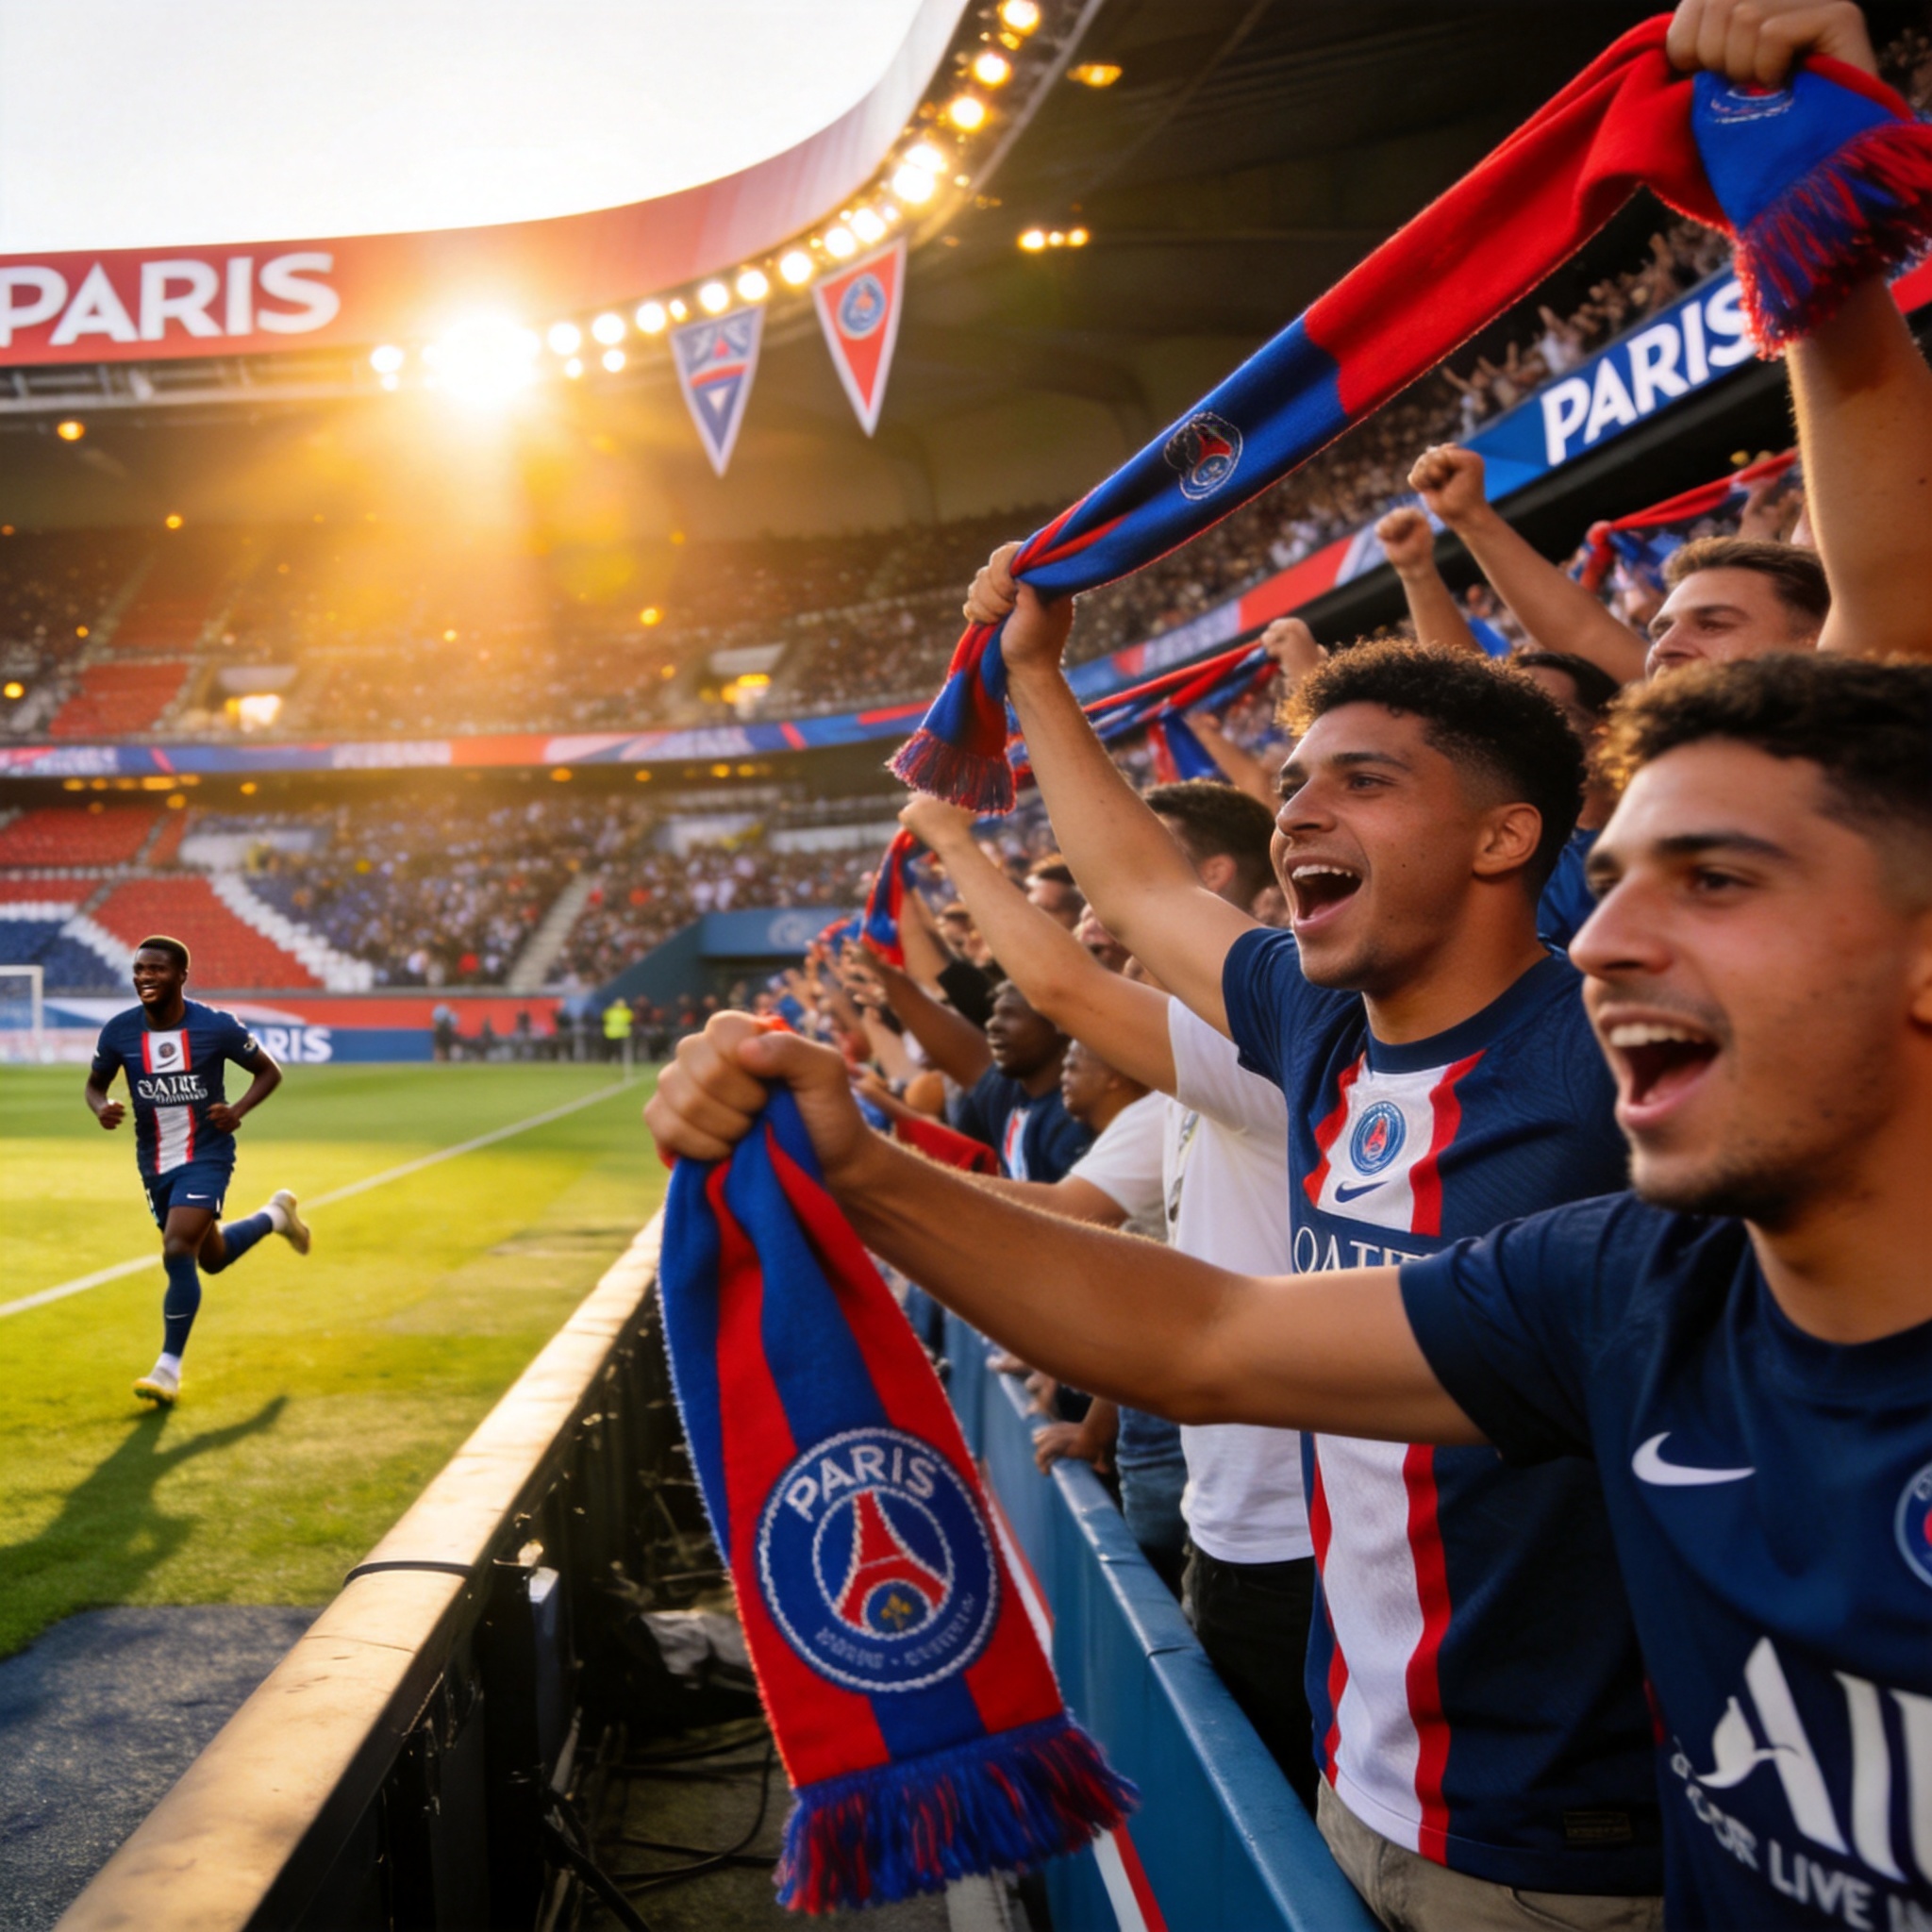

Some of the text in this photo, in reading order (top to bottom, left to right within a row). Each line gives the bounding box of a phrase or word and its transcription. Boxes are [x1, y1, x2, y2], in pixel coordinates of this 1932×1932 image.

[0, 252, 341, 348] PARIS
[1540, 281, 1757, 467] PARIS
[785, 1444, 938, 1523] PARIS
[1769, 1838, 1874, 1931] LIVE
